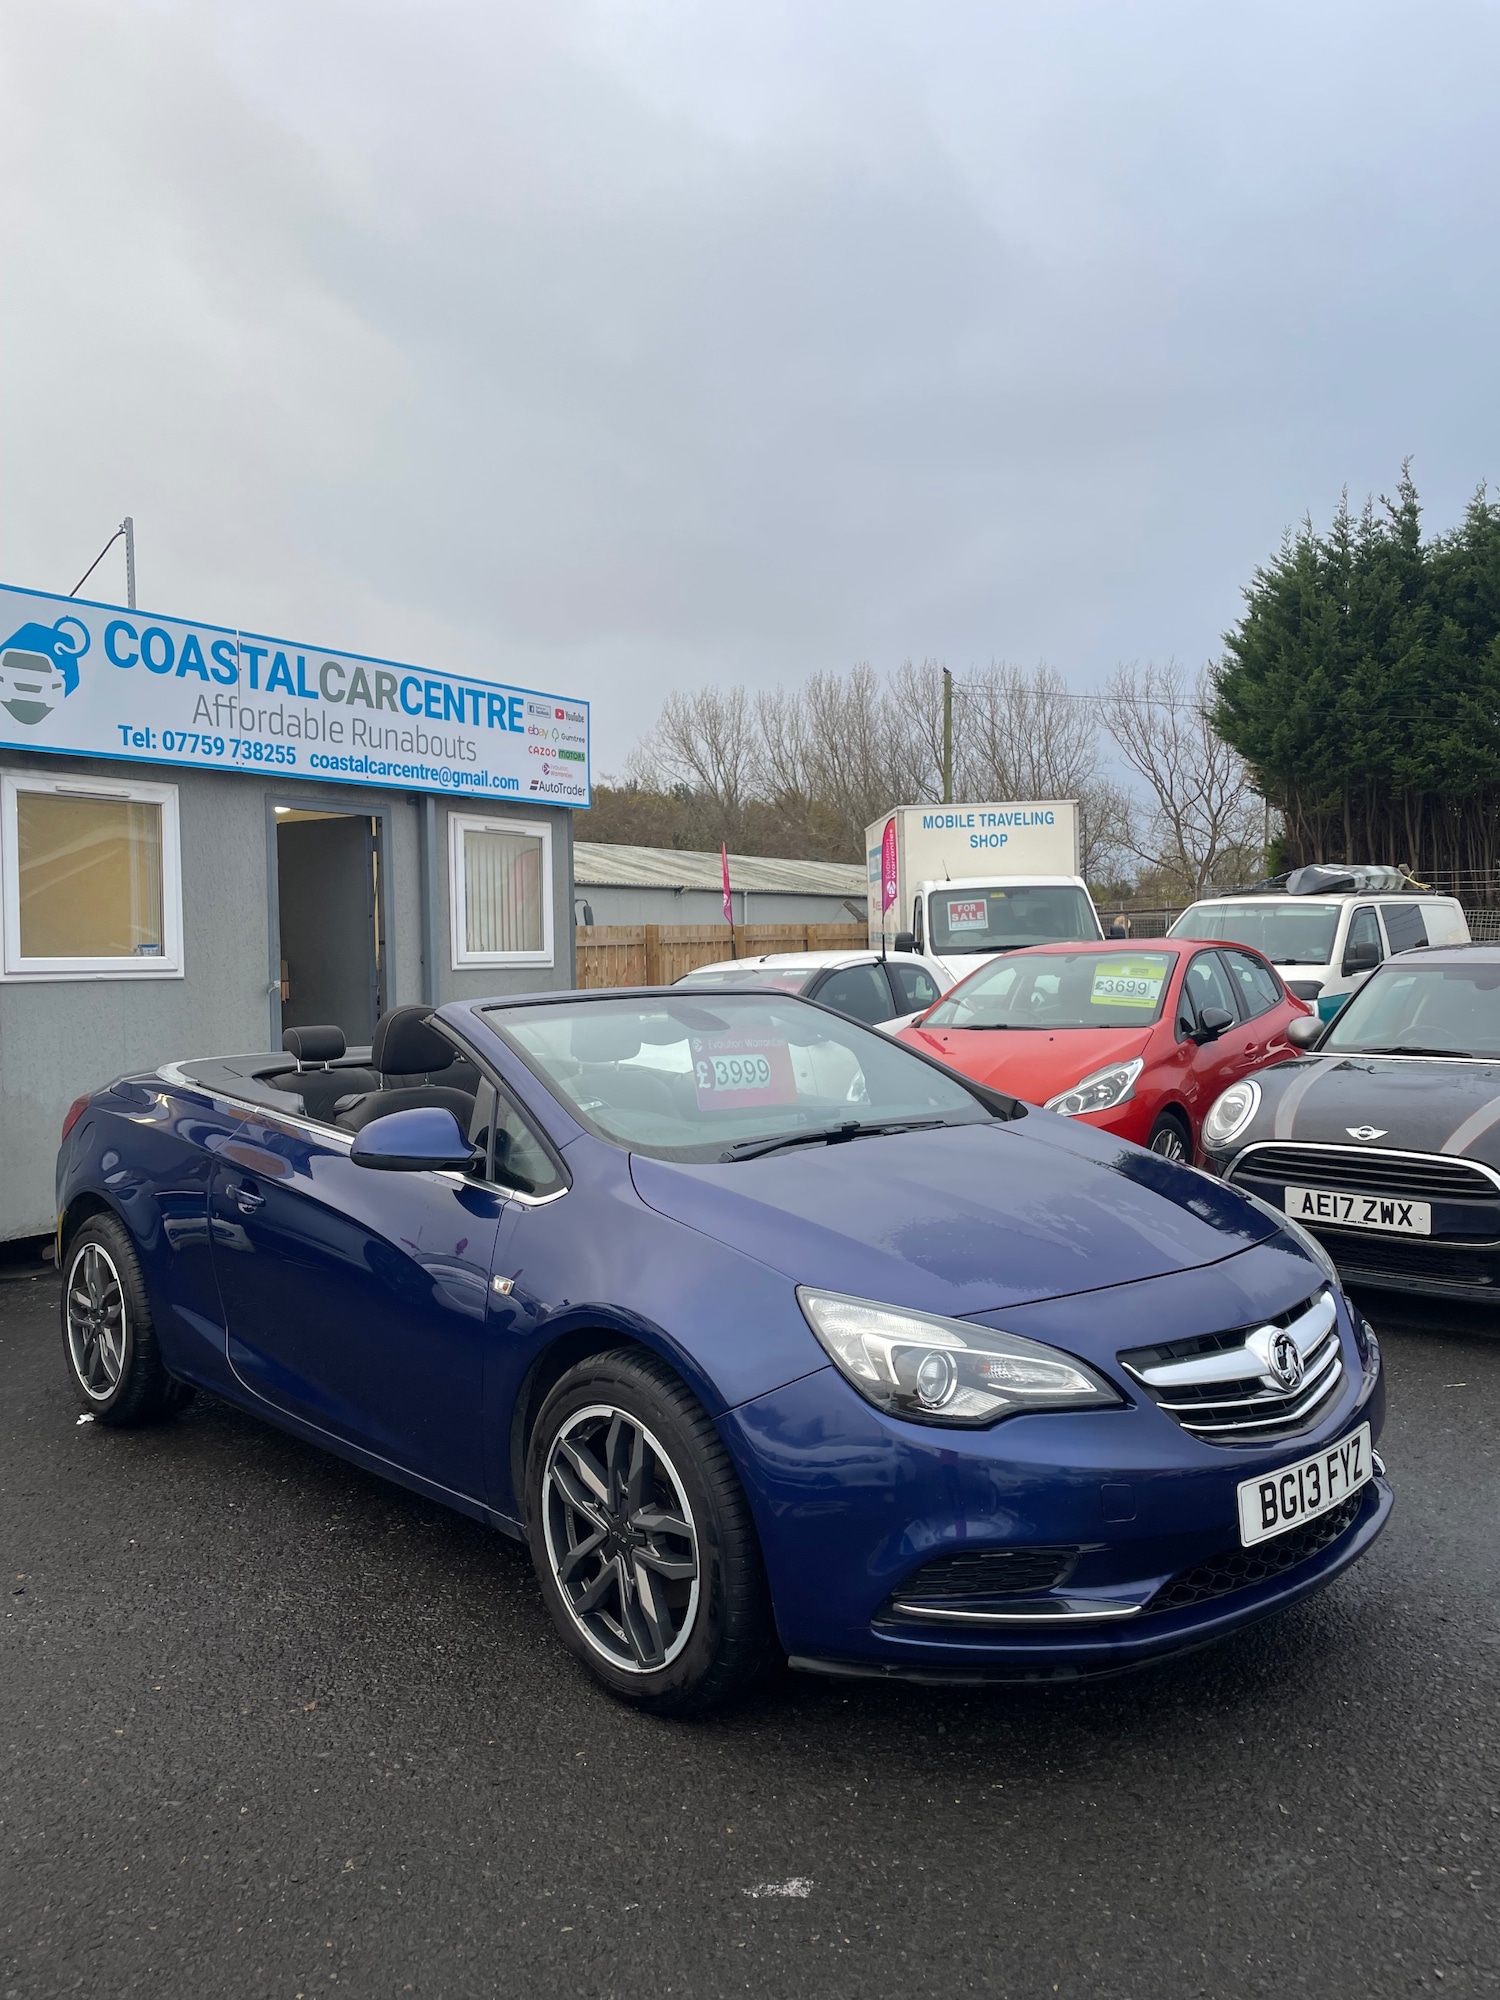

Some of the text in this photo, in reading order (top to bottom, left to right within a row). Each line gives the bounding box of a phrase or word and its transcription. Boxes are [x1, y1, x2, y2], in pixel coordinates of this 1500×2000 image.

[104, 620, 525, 734] COASTALCARCENTRE
[565, 710, 585, 723] YouTube
[192, 693, 477, 762] Affordable Runabouts
[528, 724, 549, 740] ebay
[117, 724, 297, 765] Tel: 07759 738255
[561, 733, 586, 743] Gumtree
[528, 746, 556, 758] CAZOO
[310, 753, 520, 792] coastalcarcentre@gmail.com
[538, 780, 586, 796] AutoTrader
[923, 811, 1055, 829] MOBILE TRAVELING
[970, 834, 1008, 848] SHOP
[958, 904, 976, 912] FOR
[952, 912, 984, 921] SALE
[708, 1040, 743, 1049] Evolution
[1302, 1192, 1413, 1226] AE17 ZWX
[1259, 1435, 1363, 1530] BG13 FYZ
